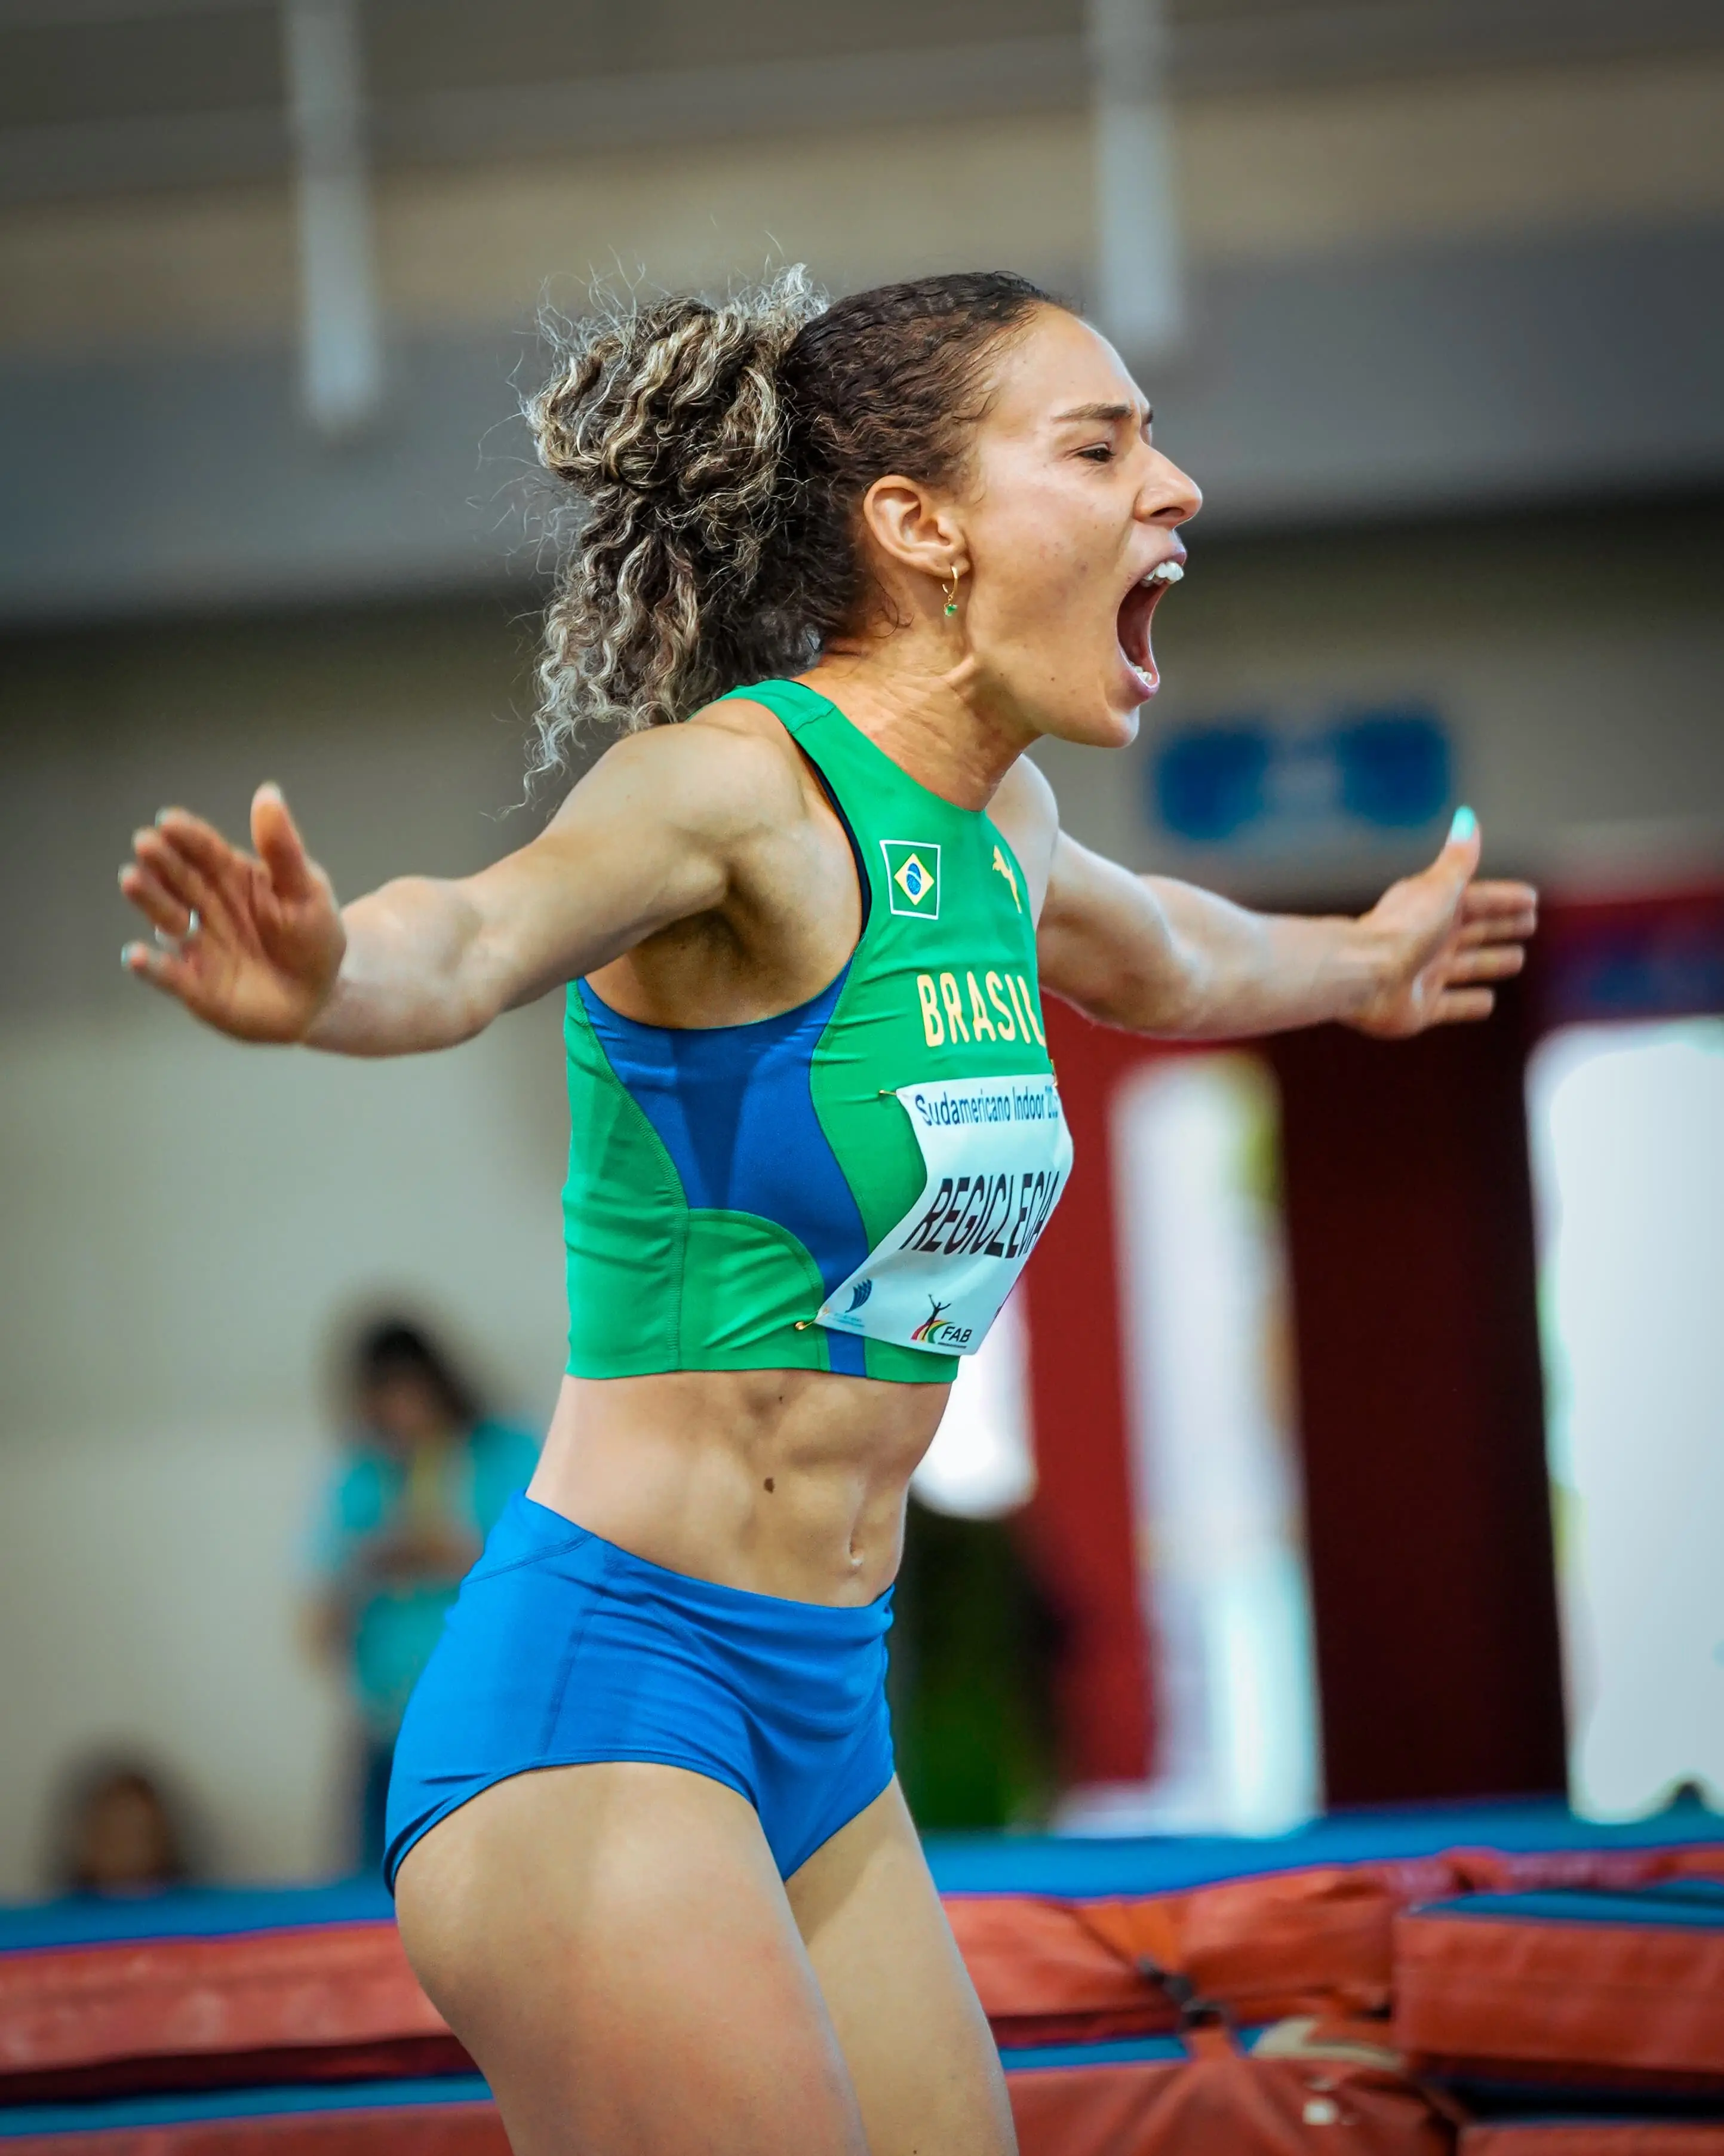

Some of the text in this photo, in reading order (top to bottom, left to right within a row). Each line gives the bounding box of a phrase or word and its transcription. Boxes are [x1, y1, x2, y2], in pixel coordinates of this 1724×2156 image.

[917, 971, 1046, 1047] BRASIL
[915, 1089, 1010, 1126] Sudamericano
[1013, 1086, 1044, 1119] Indoor
[941, 1326, 972, 1342] FAB
